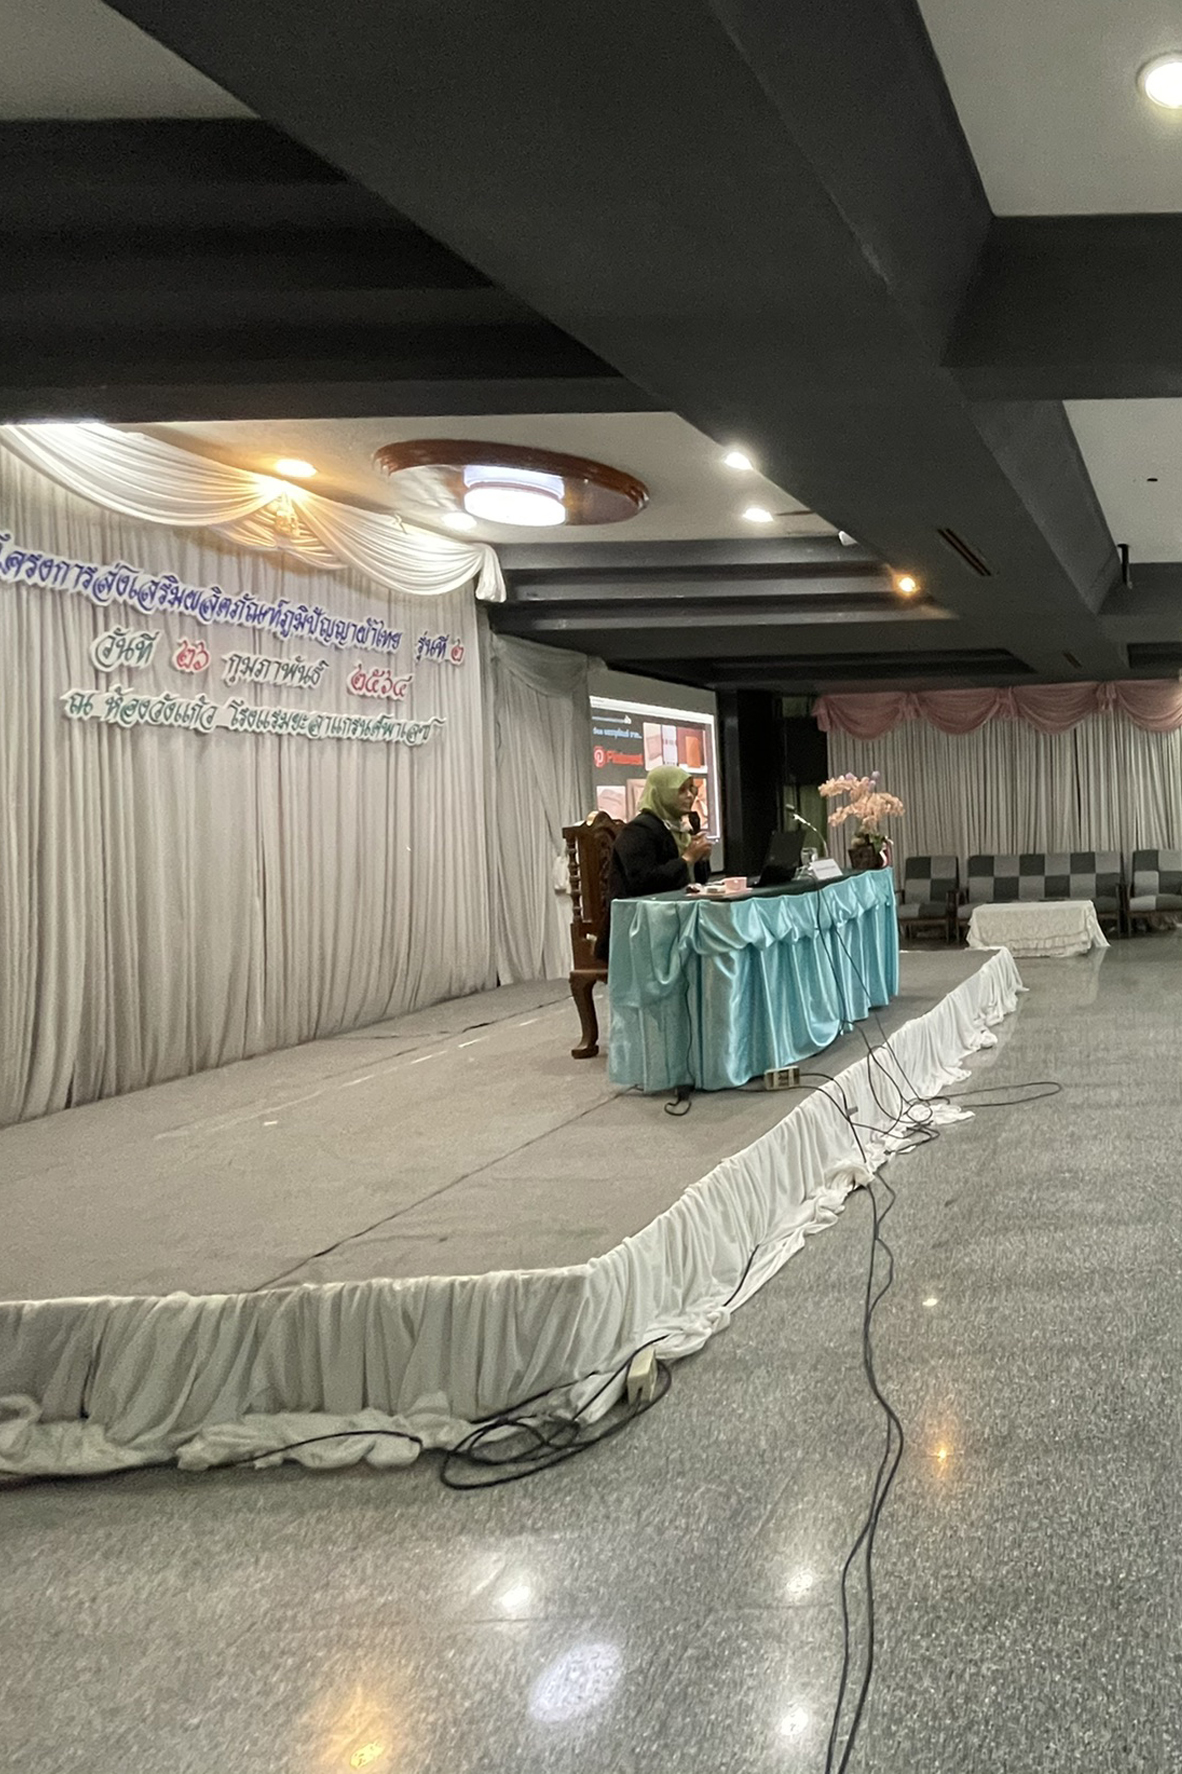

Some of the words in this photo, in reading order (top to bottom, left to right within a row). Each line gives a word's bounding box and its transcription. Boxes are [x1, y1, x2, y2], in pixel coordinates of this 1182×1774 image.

[176, 640, 209, 671] ๒๖
[228, 653, 329, 685] กุมภาพันธ์
[351, 664, 412, 697] ๒๕๖๔
[69, 692, 94, 714] ณ
[105, 686, 217, 731] ห้องวังแก้ว
